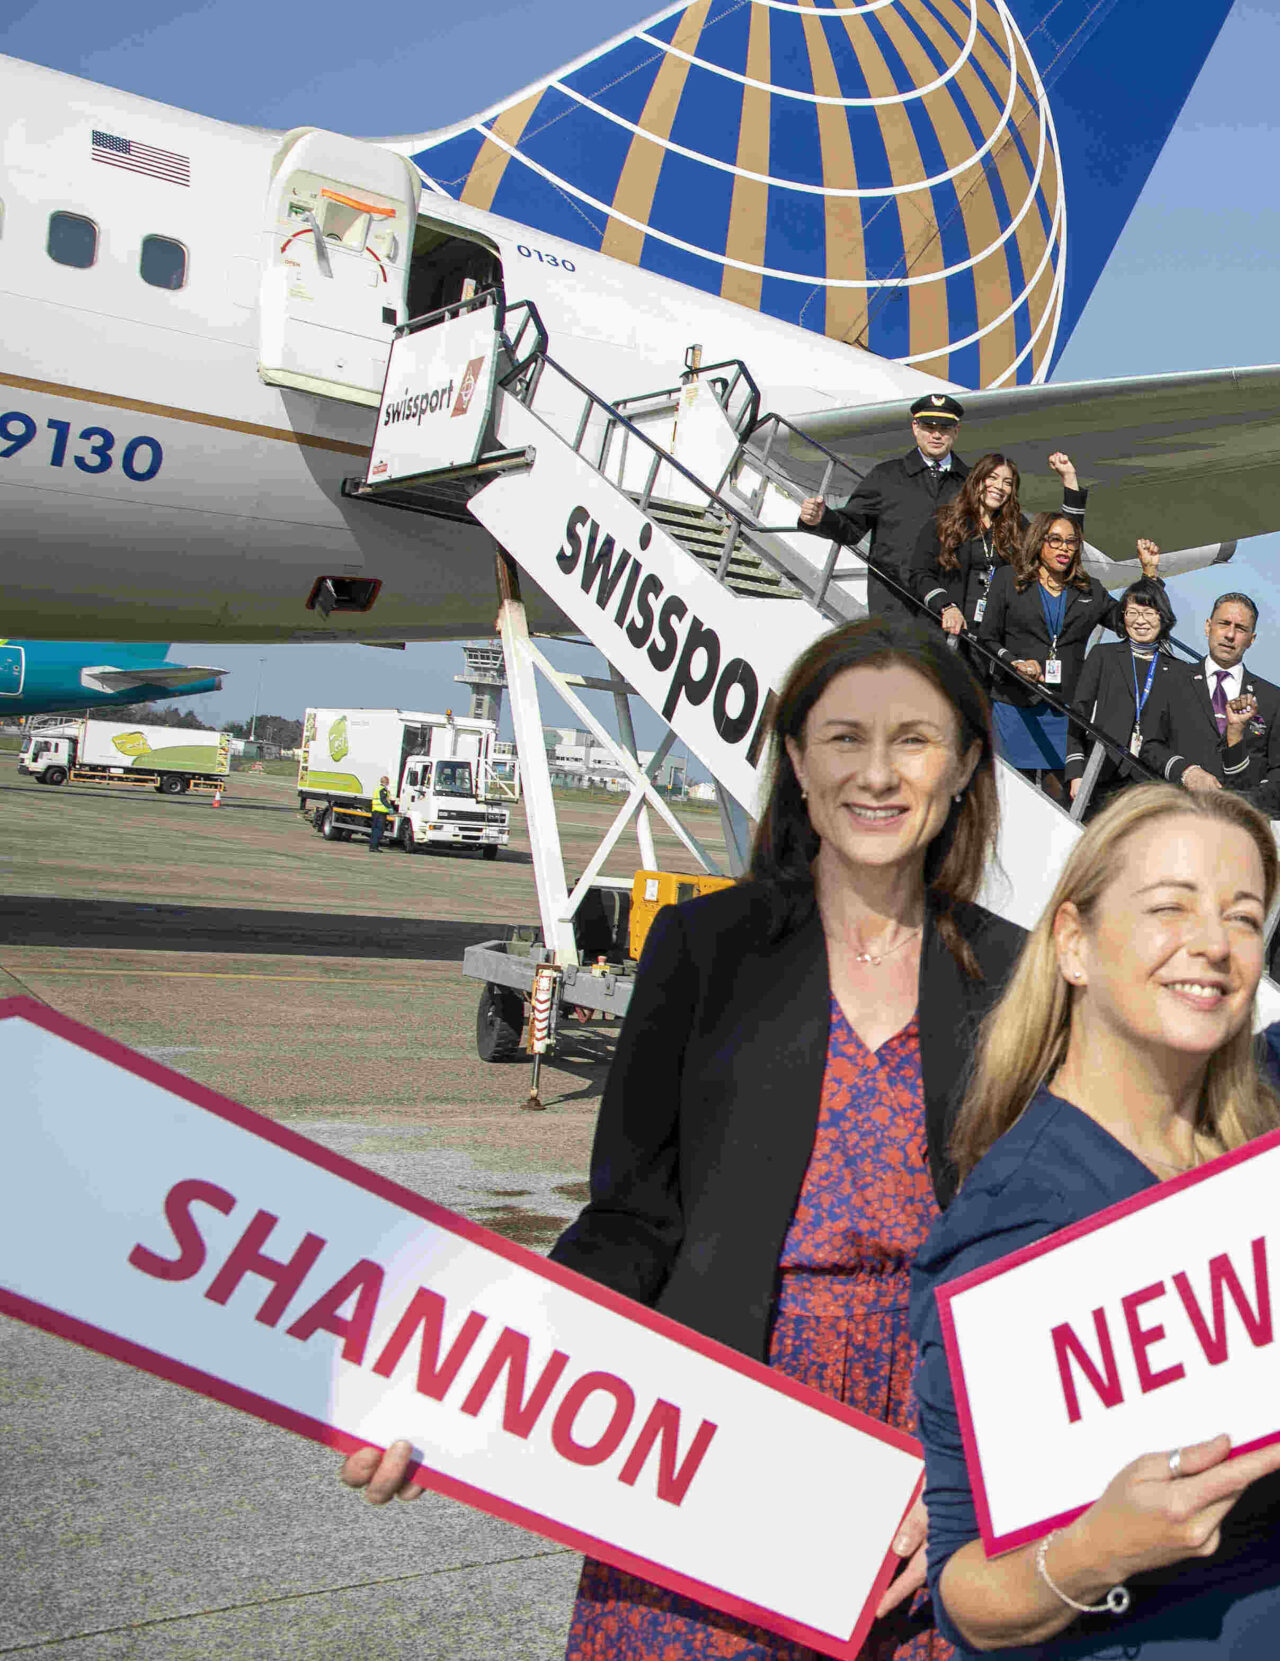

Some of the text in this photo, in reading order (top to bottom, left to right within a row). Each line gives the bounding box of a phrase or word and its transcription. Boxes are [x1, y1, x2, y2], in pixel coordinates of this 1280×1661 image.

[517, 244, 576, 273] 0130
[384, 379, 454, 426] swissport
[0, 411, 164, 482] 9130
[130, 1181, 717, 1506] SHANNON
